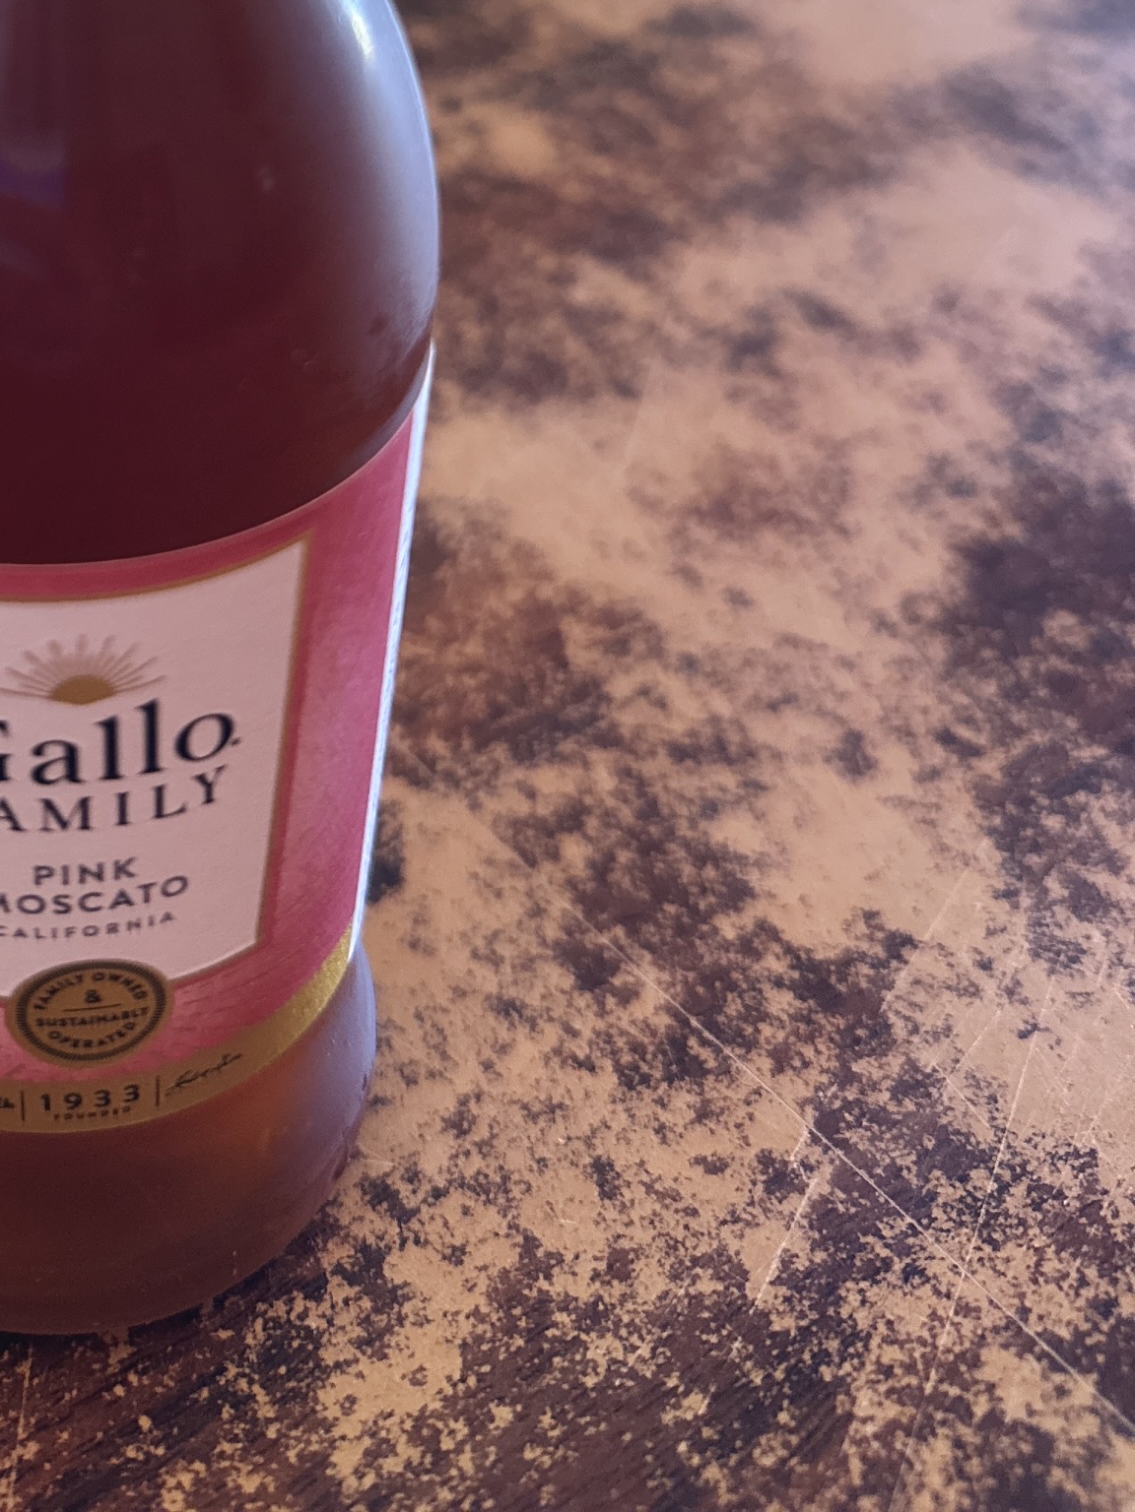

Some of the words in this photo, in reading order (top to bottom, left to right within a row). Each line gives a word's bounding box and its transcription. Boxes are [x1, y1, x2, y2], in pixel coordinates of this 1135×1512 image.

[33, 857, 138, 886] PINK
[33, 974, 84, 1010] FAMILY
[92, 972, 148, 1001] OWNED
[84, 989, 101, 1004] &
[50, 1021, 137, 1048] OPERATED
[40, 1084, 141, 1111] 1933
